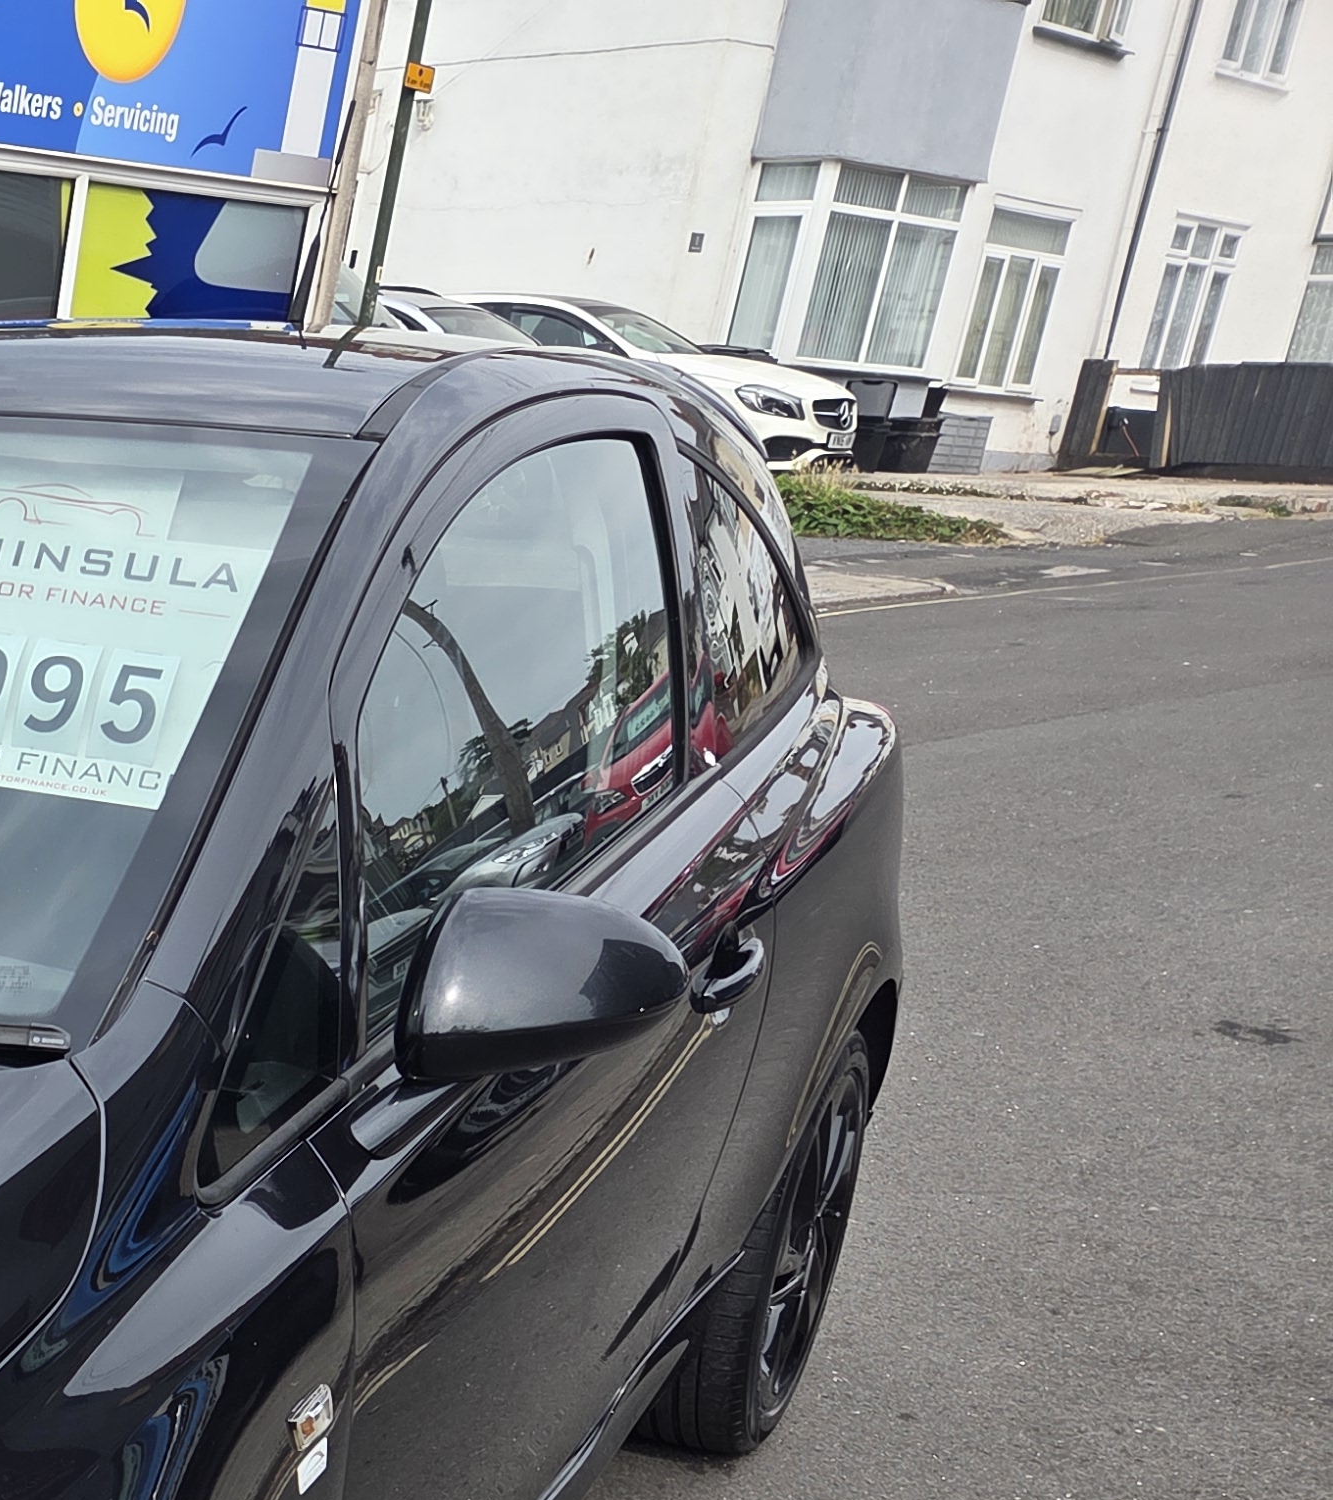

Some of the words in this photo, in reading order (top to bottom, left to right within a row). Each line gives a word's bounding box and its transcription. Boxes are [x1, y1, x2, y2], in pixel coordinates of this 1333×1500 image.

[89, 96, 180, 142] Servicing
[45, 587, 167, 616] FINANCE
[16, 751, 175, 791] FINANC
